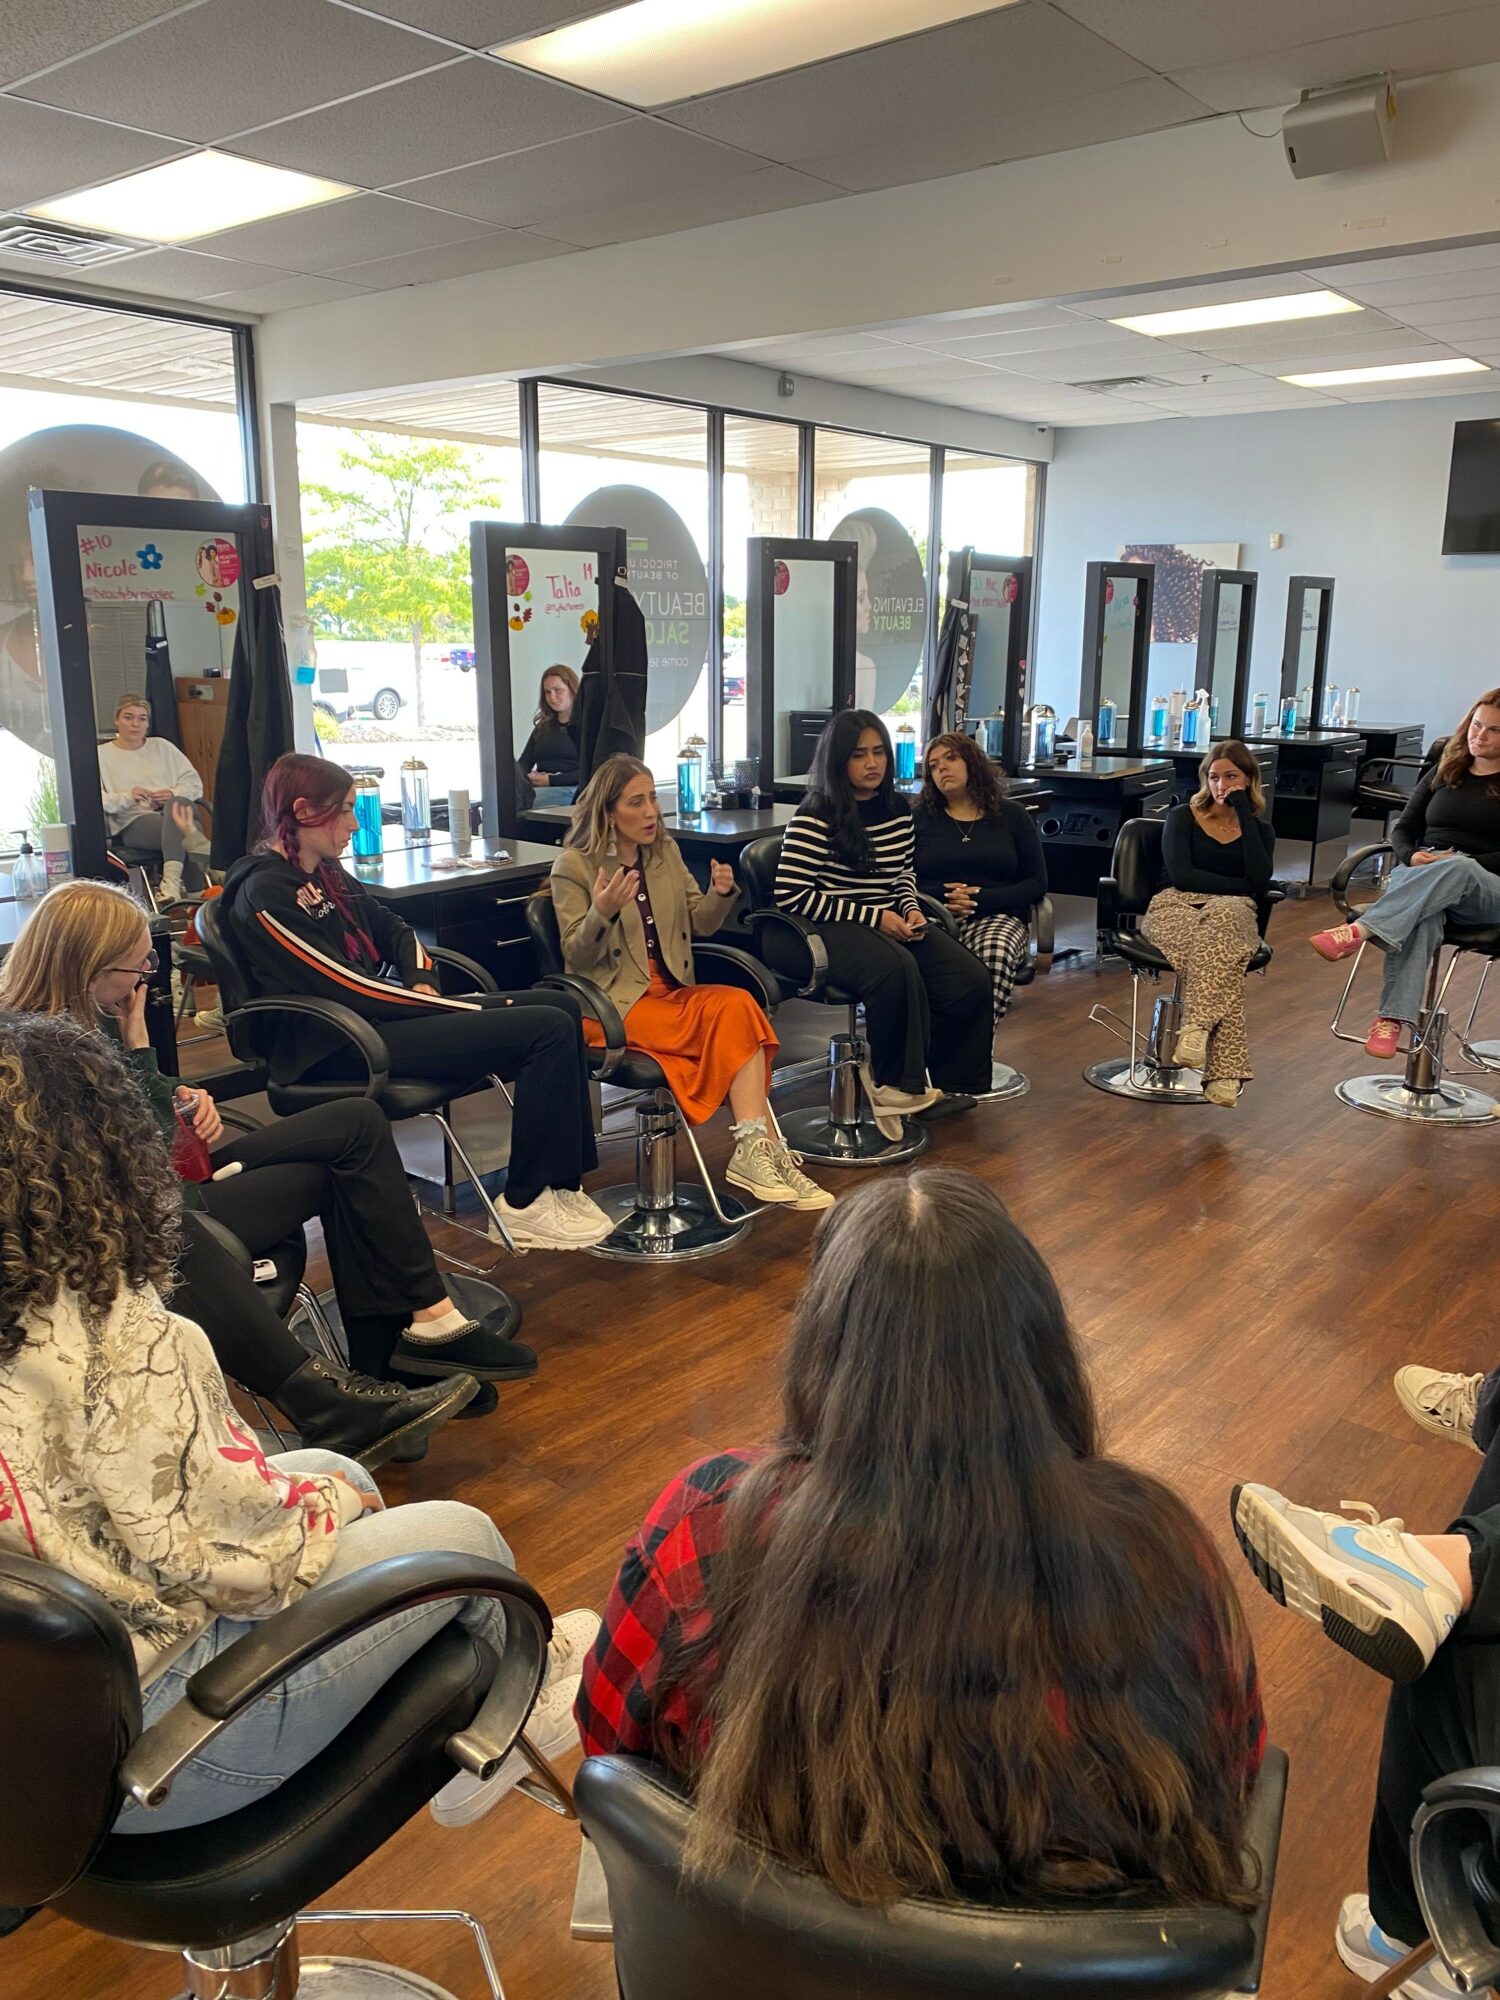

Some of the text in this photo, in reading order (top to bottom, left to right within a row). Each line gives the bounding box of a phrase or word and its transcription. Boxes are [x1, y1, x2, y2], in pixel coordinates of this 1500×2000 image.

[80, 534, 112, 555] #10
[85, 559, 137, 579] Nicole
[545, 574, 582, 599] Talia
